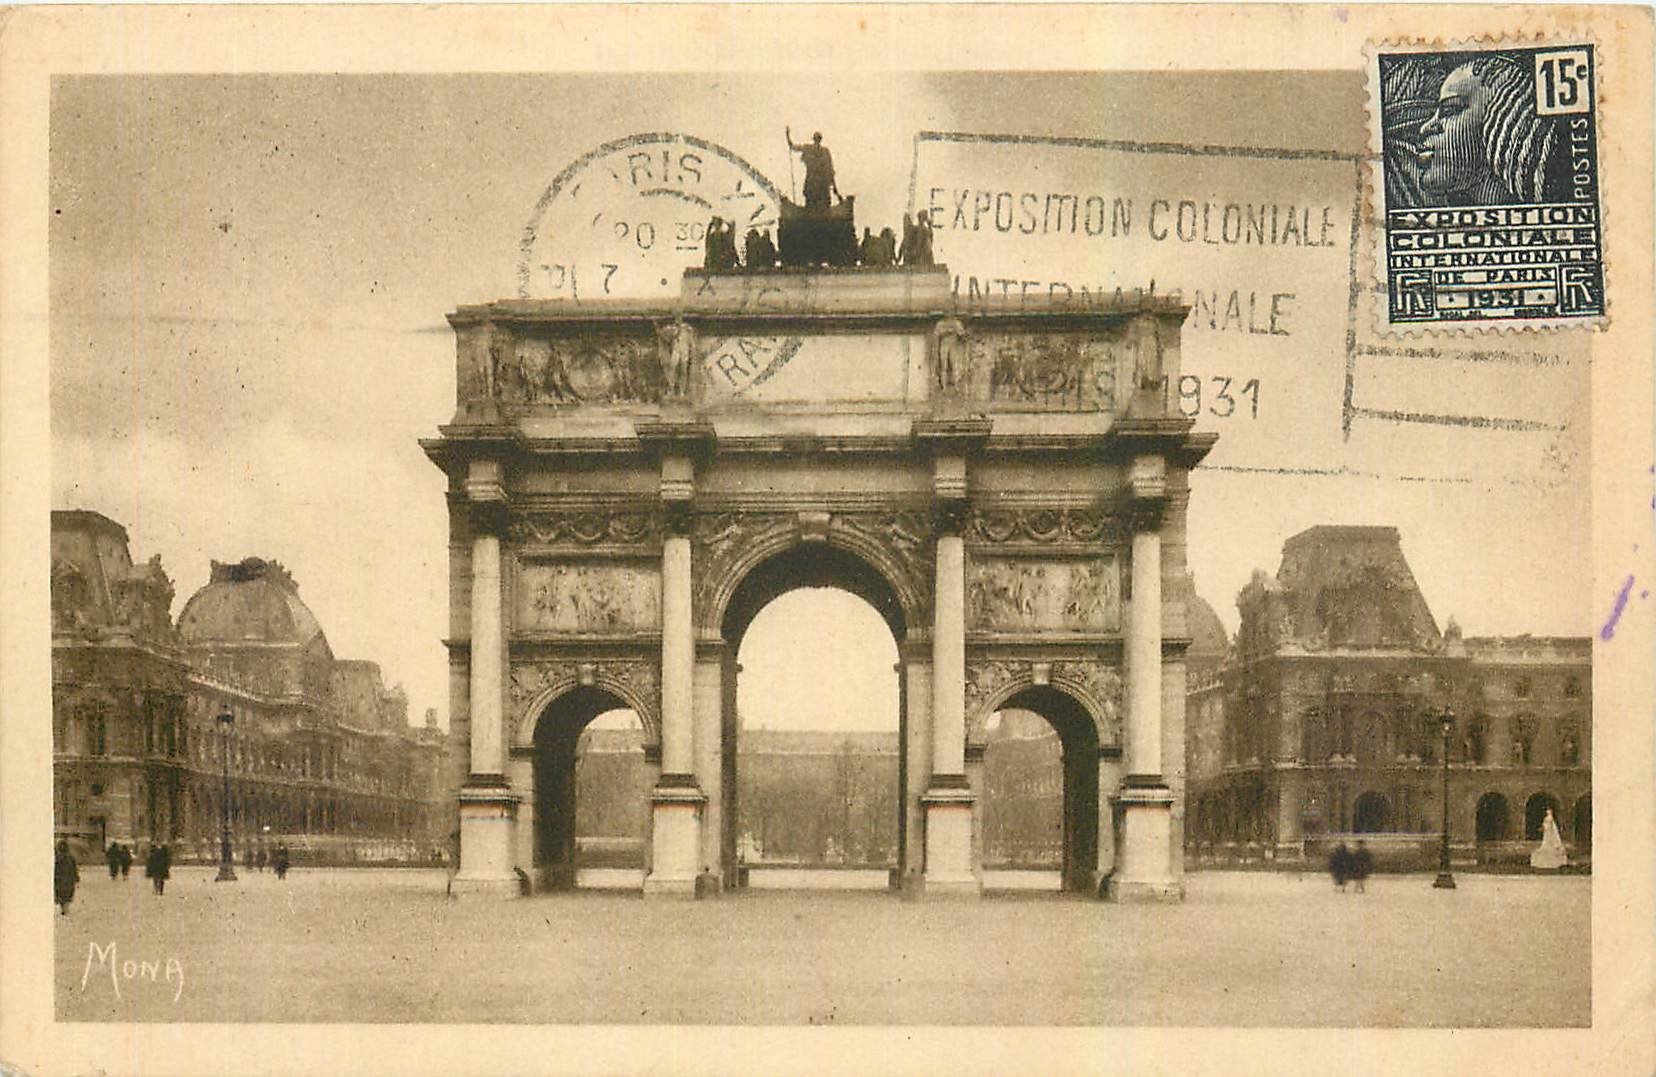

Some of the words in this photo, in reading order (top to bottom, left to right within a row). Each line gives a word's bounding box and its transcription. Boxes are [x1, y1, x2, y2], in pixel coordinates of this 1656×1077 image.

[1571, 117, 1591, 199] POSTES
[929, 187, 1133, 238] EXPOSITION
[1148, 199, 1336, 248] COLONIALE
[1392, 207, 1595, 230] EXPOSITION
[1392, 229, 1597, 250] COLONIALE
[1391, 251, 1598, 268] INTERNATIONALE
[1435, 271, 1464, 284] DE
[1486, 268, 1555, 282] PARIS
[1469, 291, 1524, 308] 1931
